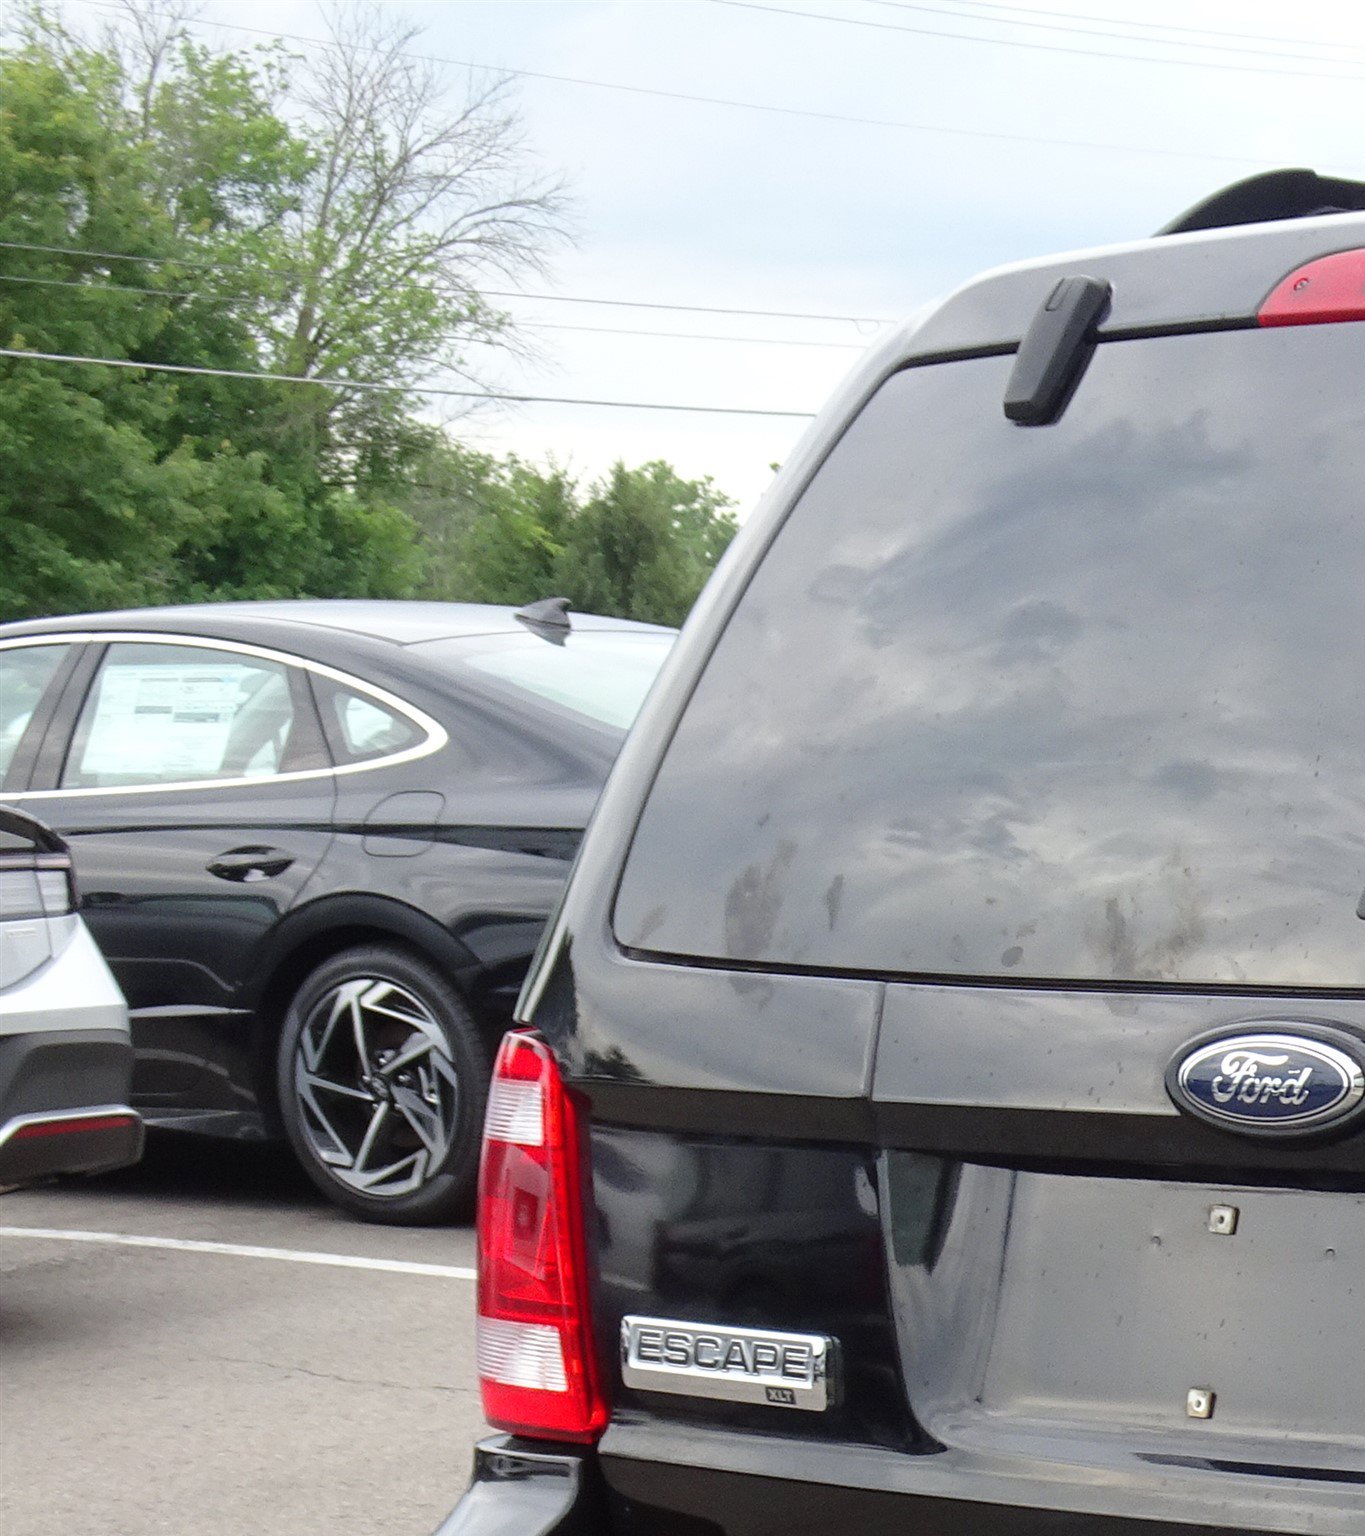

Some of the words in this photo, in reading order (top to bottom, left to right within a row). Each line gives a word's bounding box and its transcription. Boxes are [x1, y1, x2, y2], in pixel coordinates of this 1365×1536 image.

[1212, 1050, 1313, 1106] Ford
[636, 1327, 812, 1382] ESCAPE
[768, 1389, 793, 1402] XLT
